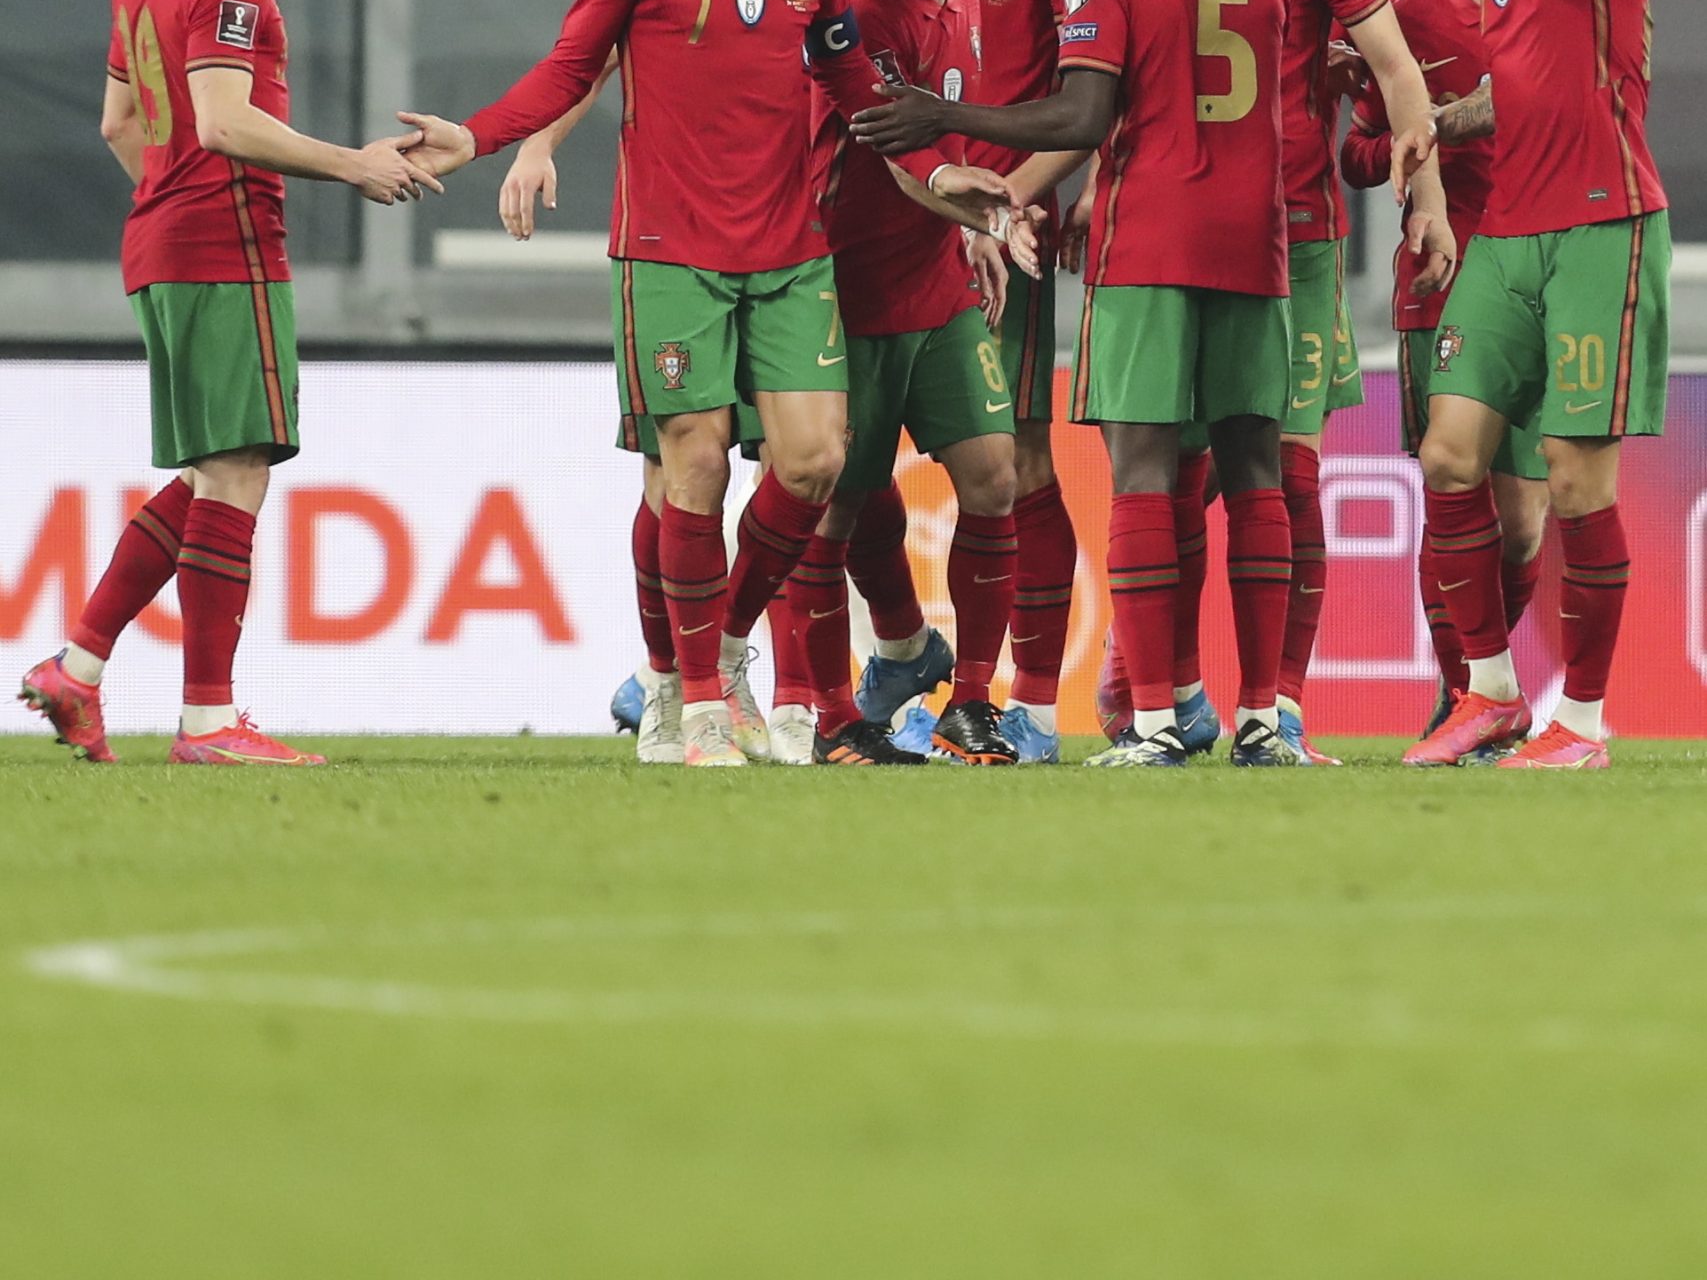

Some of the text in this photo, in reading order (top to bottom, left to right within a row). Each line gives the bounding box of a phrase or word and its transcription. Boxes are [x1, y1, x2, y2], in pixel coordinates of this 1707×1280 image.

[825, 23, 849, 51] C
[819, 291, 839, 347] 7
[977, 341, 1005, 392] 8
[1301, 332, 1322, 390] 3
[1555, 334, 1605, 392] 20
